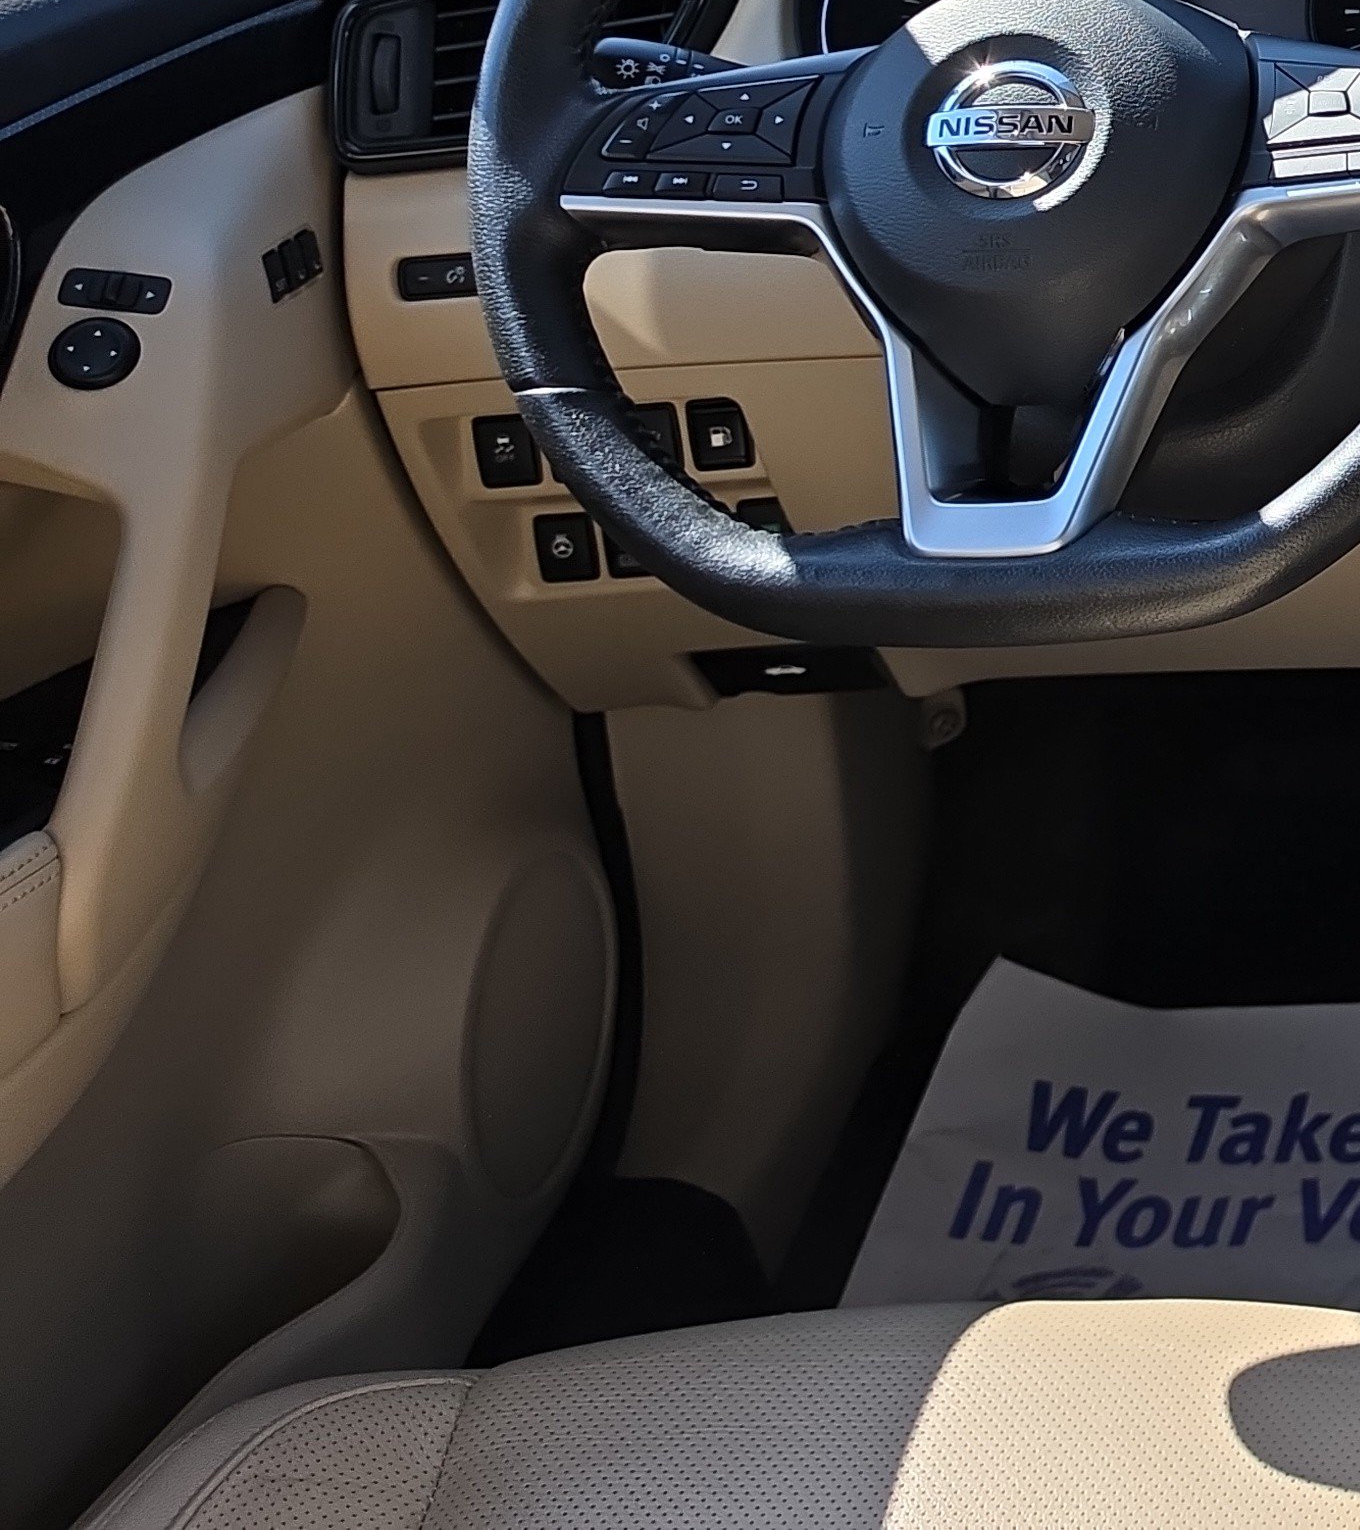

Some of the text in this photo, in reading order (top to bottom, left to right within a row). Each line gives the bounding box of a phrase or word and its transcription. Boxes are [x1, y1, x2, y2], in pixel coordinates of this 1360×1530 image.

[724, 115, 743, 125] OK
[938, 114, 1074, 138] NISSAN
[1023, 1079, 1155, 1163] We
[948, 1160, 1042, 1245] In
[1073, 1175, 1275, 1249] Your
